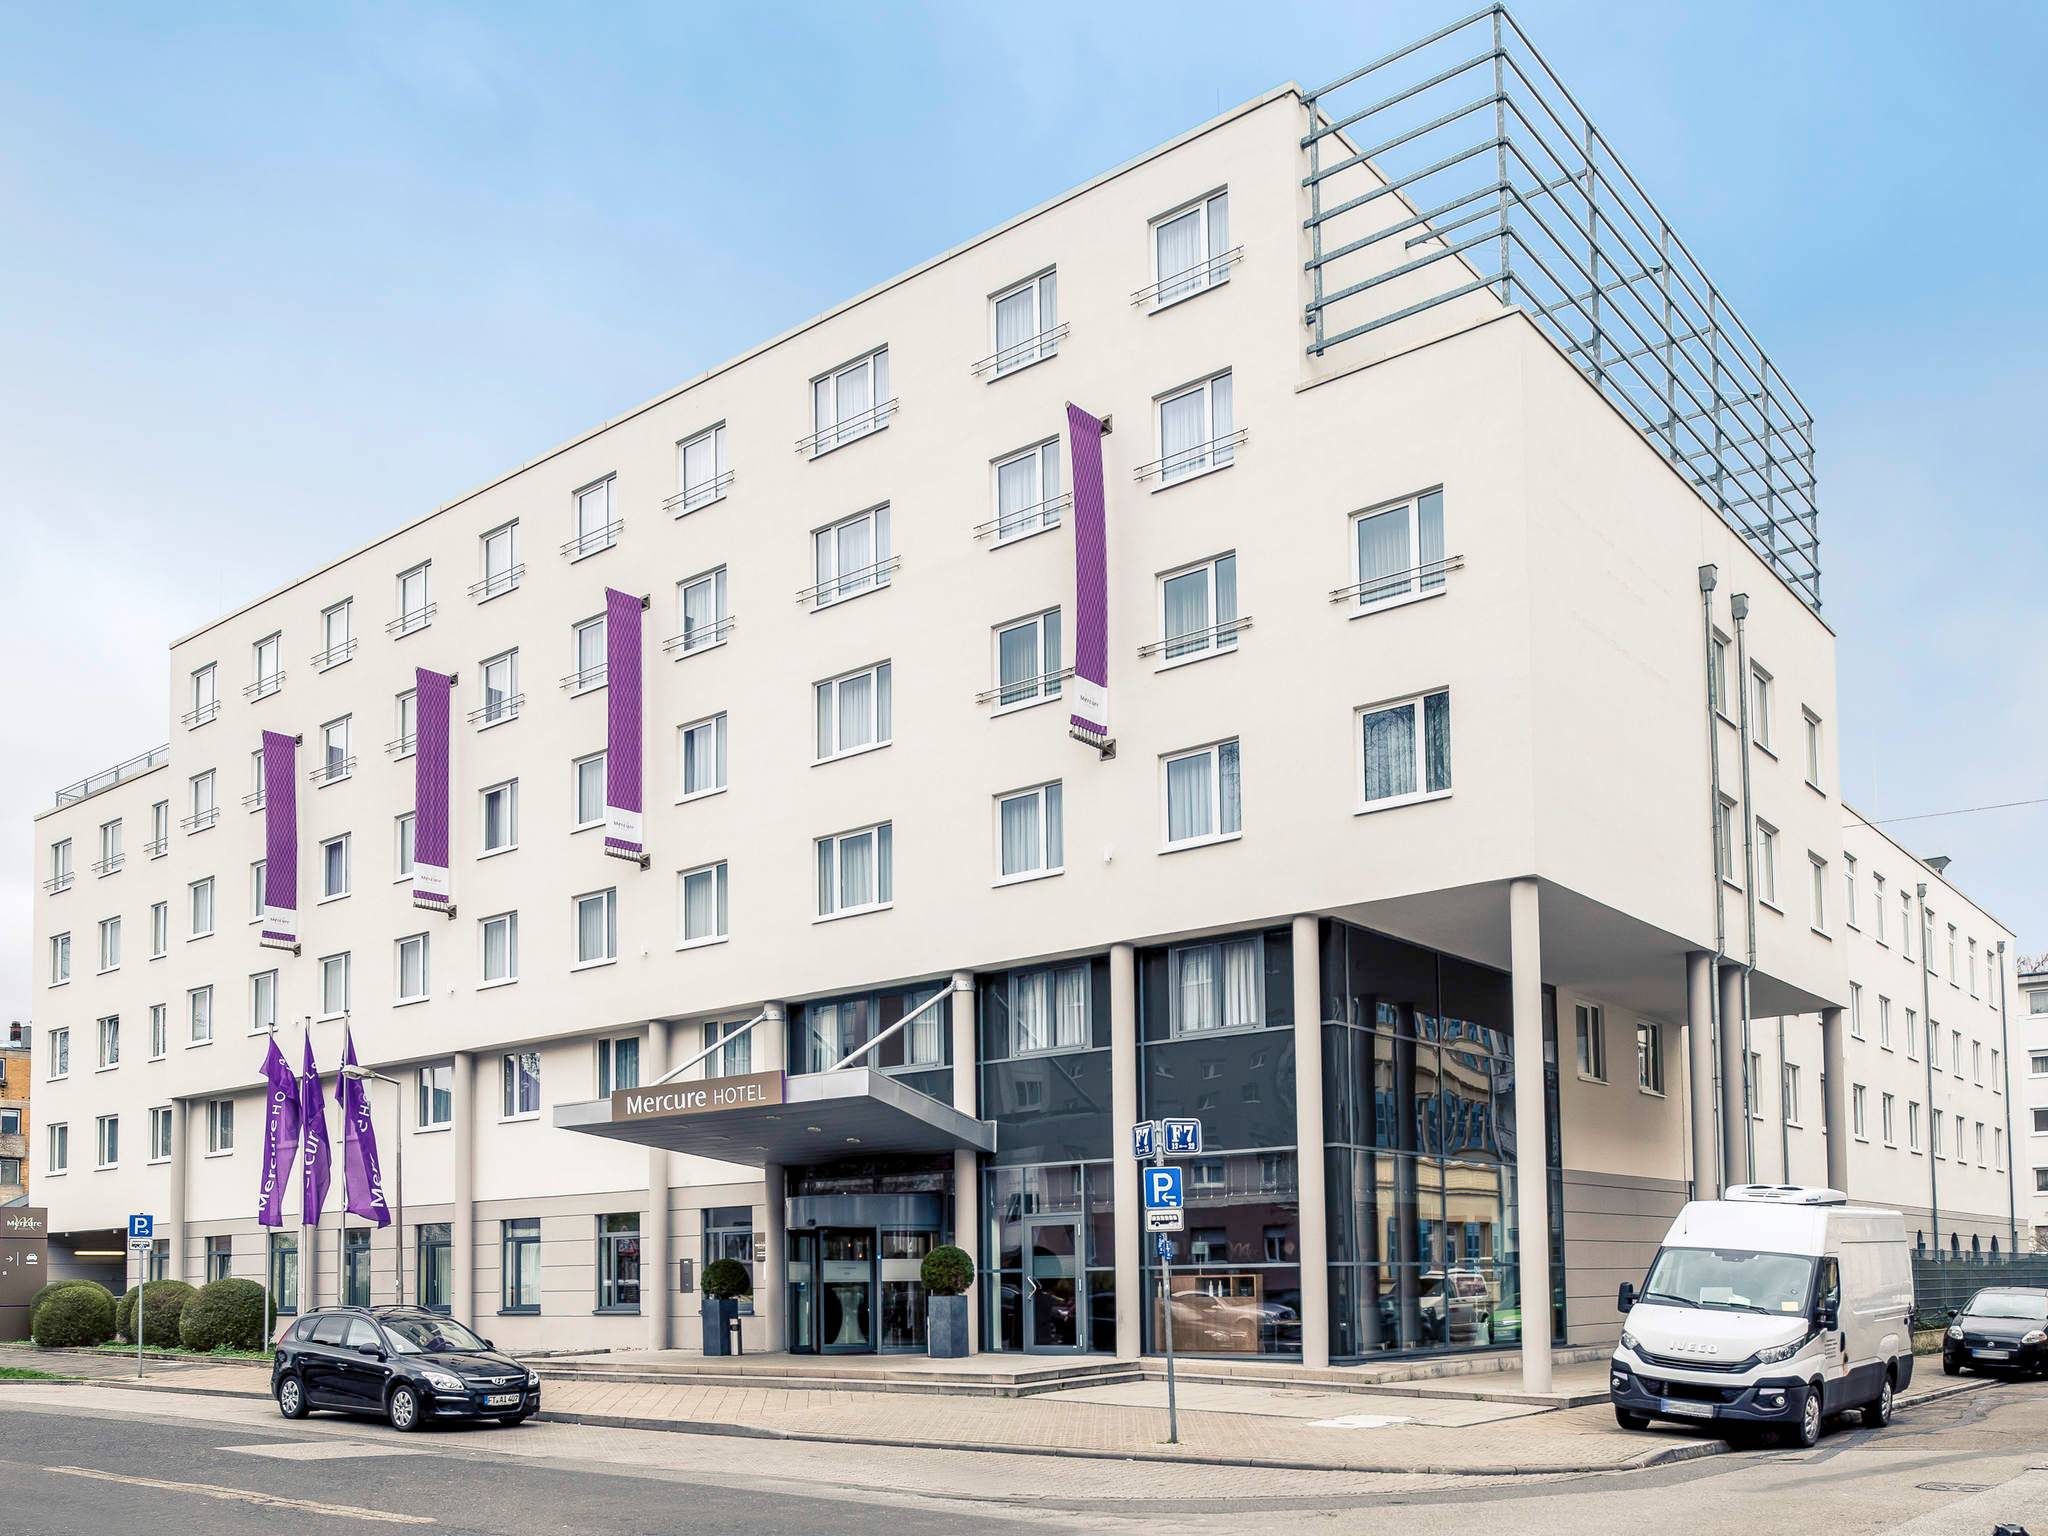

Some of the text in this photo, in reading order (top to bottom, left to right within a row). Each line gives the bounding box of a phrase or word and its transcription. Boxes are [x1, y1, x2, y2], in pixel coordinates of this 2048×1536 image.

[626, 1084, 766, 1115] Mercure HOTEL
[1135, 1128, 1150, 1148] F7
[1170, 1125, 1194, 1142] F7
[258, 1119, 278, 1212] Mercure
[1153, 1172, 1173, 1203] P
[134, 1217, 148, 1235] P
[1667, 1341, 1718, 1354] IVECO
